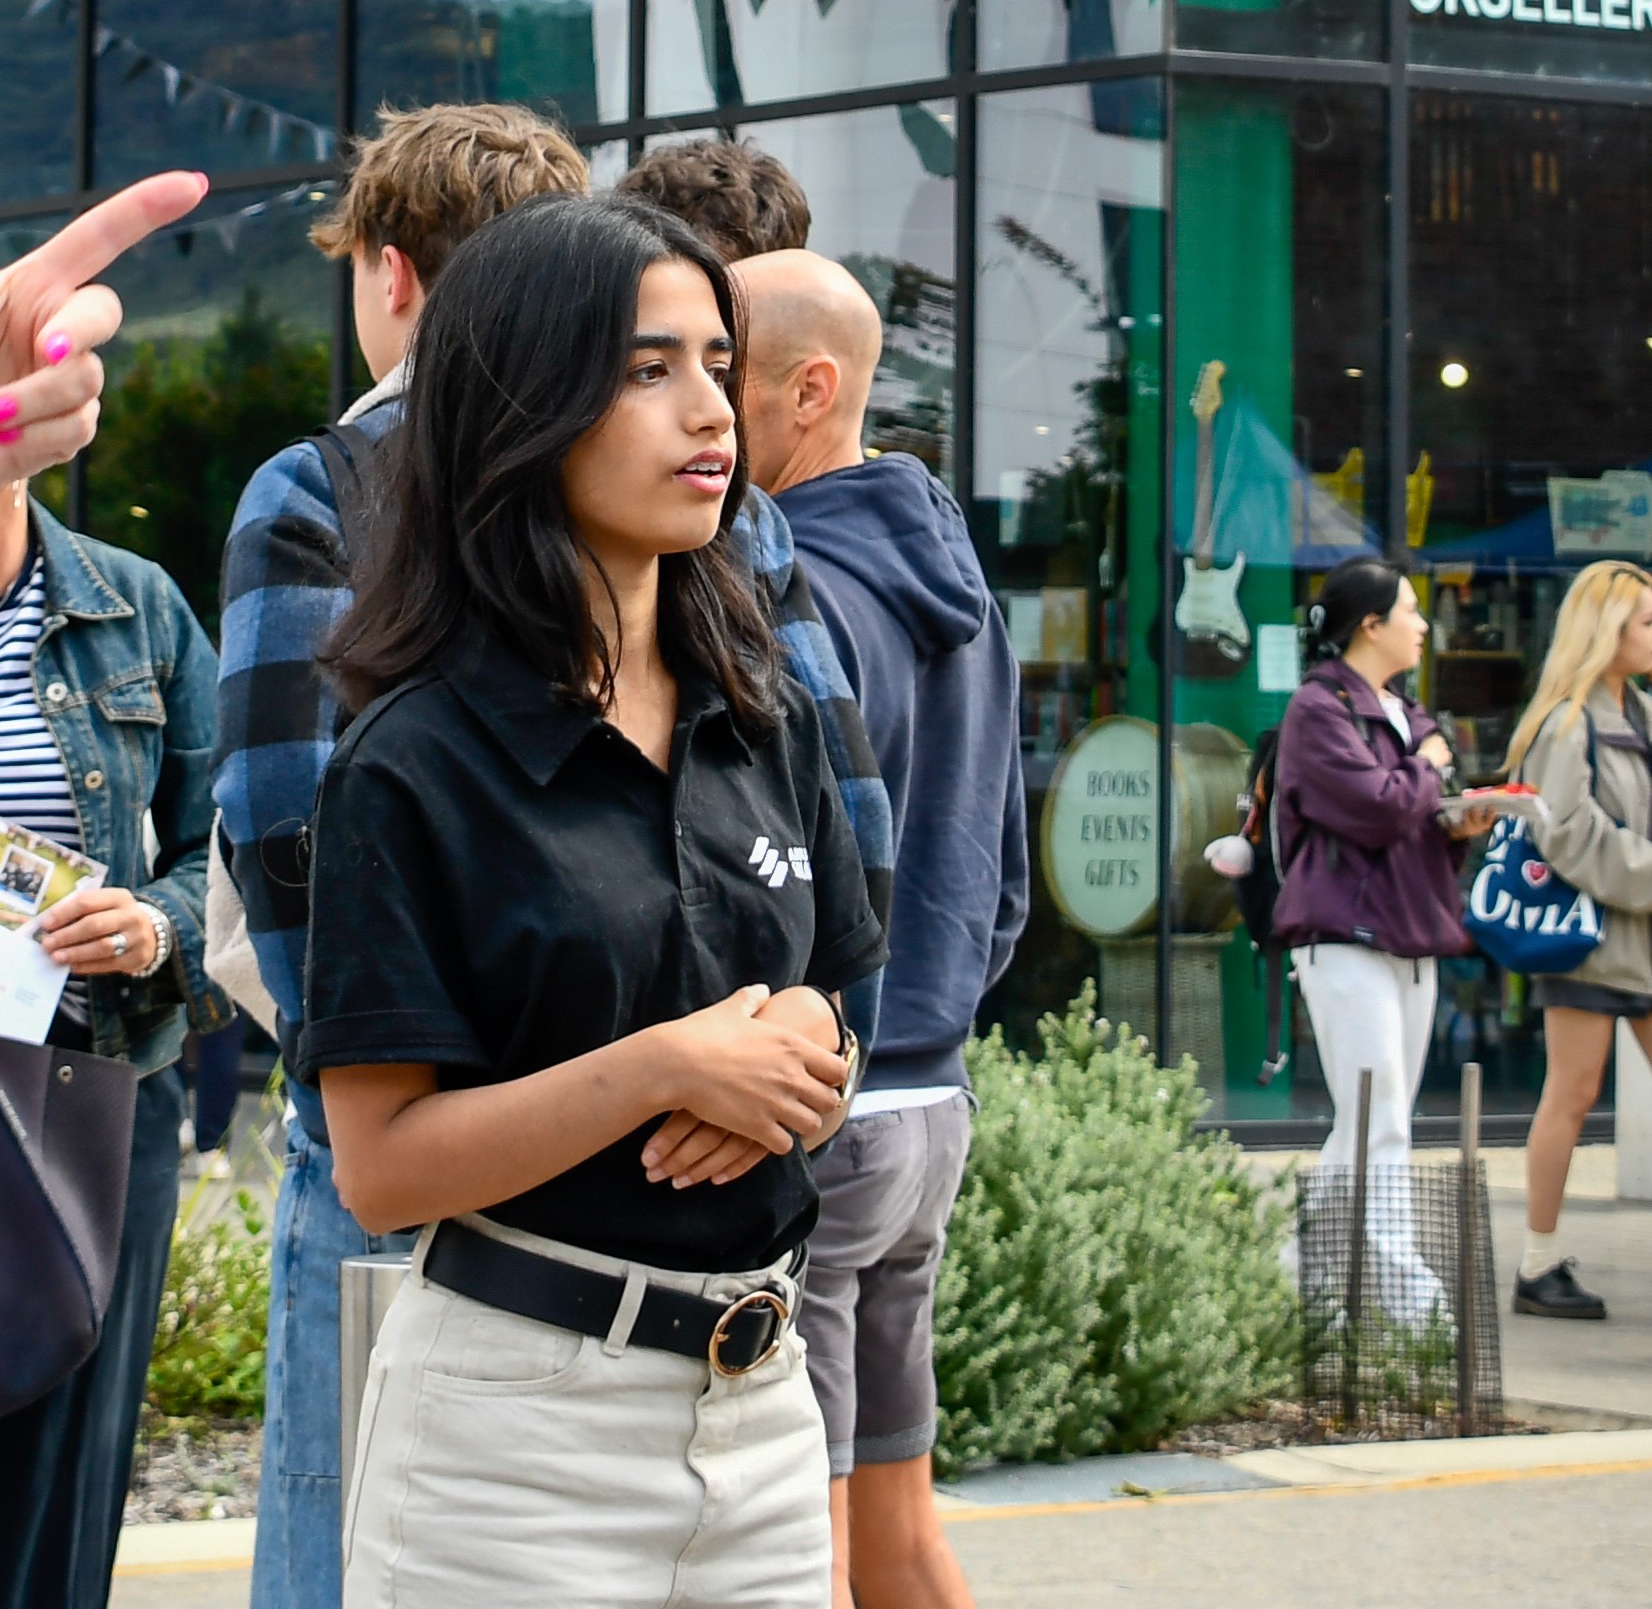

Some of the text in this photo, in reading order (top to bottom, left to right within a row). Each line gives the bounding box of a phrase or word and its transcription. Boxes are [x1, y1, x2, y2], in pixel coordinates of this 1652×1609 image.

[1086, 769, 1151, 797] BOOKS
[1080, 813, 1151, 842] EVENTS
[1084, 858, 1140, 887] GIFTS
